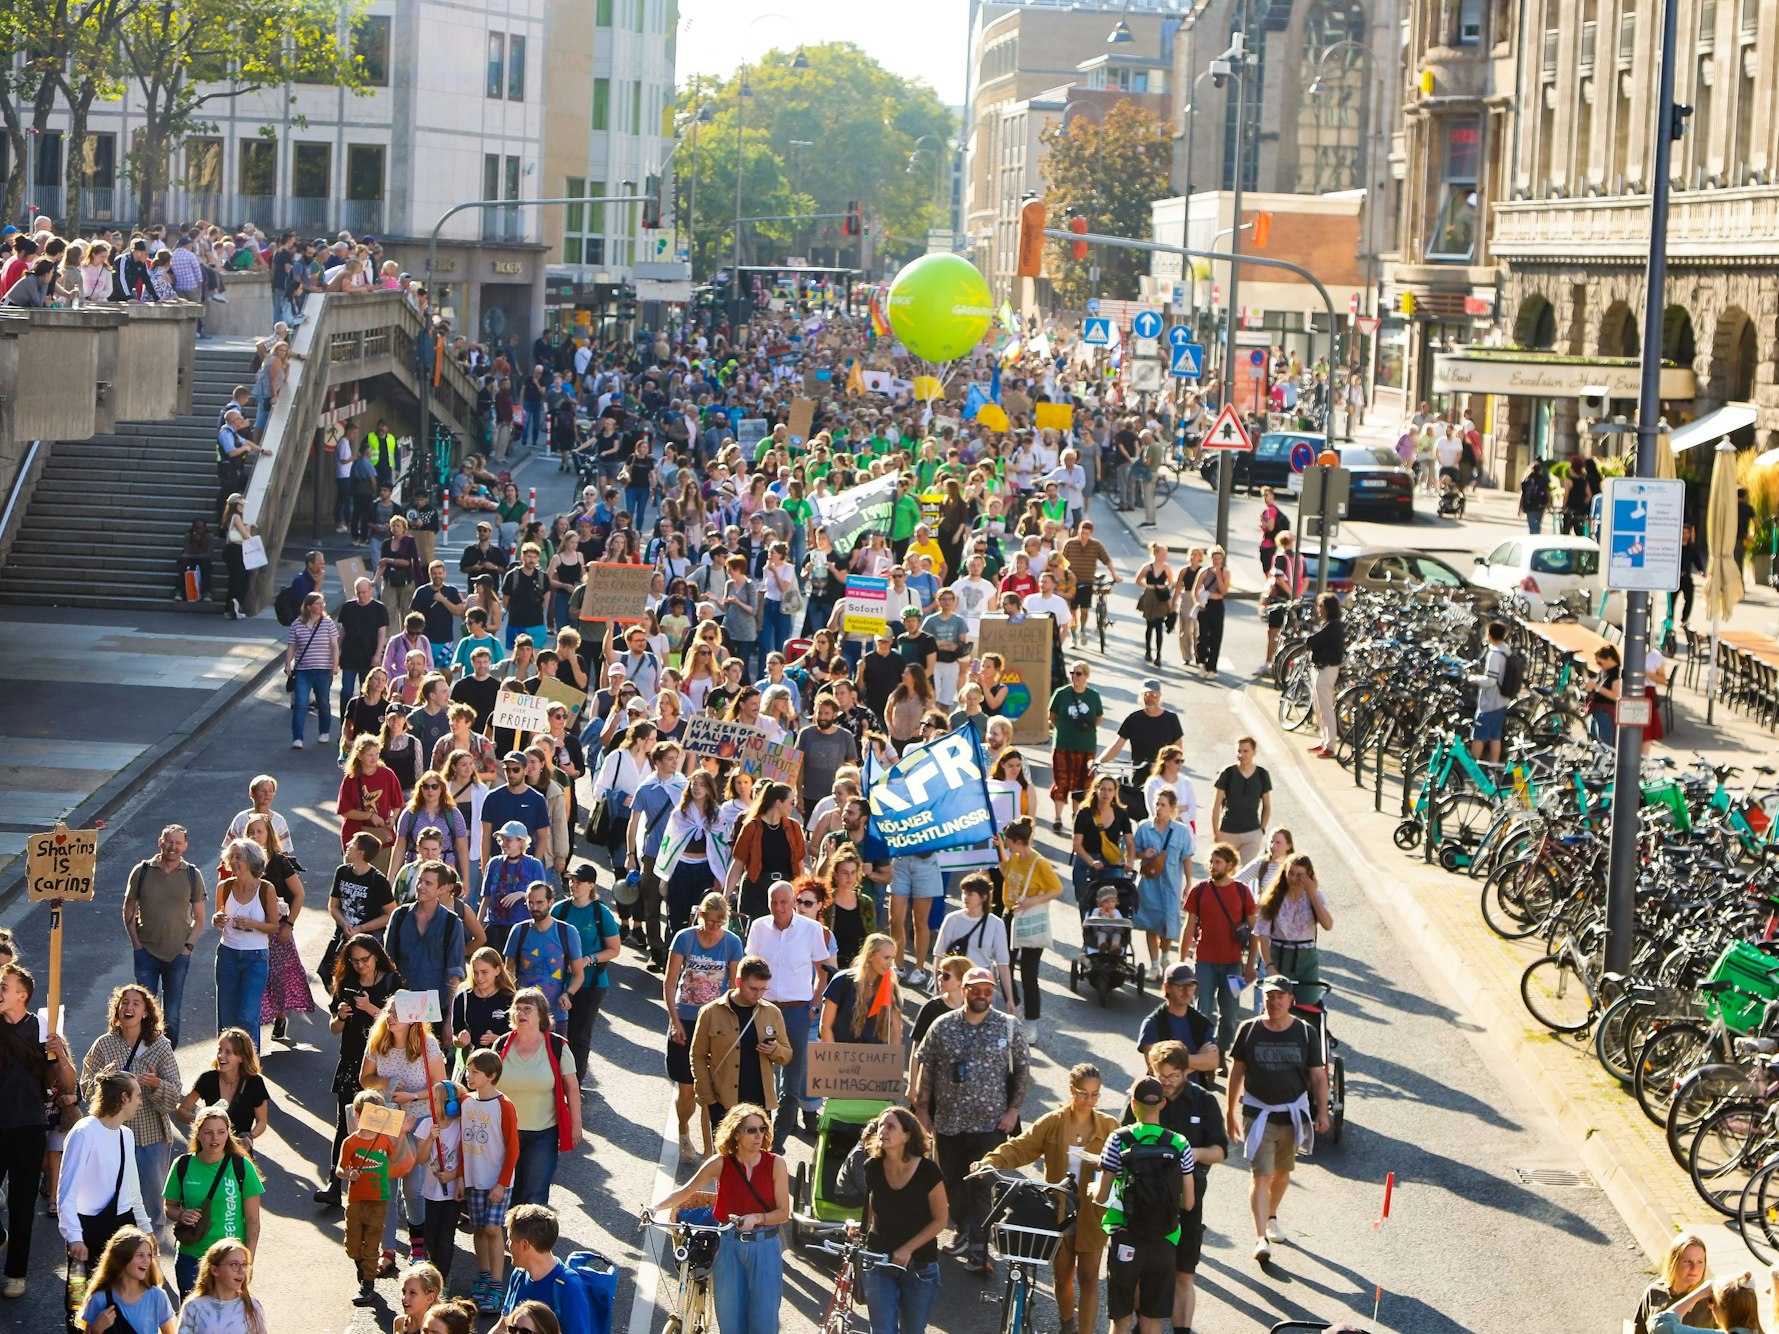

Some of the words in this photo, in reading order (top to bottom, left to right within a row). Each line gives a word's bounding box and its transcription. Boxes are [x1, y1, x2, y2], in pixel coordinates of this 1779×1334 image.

[1509, 371, 1564, 388] Excelsior
[848, 603, 884, 614] Sofort!
[981, 629, 1007, 643] WIR
[1009, 627, 1047, 643] HABEN
[1013, 644, 1045, 660] EINE
[502, 692, 541, 710] PEOPLE
[499, 712, 540, 730] PROFIT
[691, 719, 710, 731] ICH
[746, 736, 764, 751] NO
[756, 752, 795, 773] WITHOUT
[877, 810, 935, 835] KÖLNER
[37, 837, 95, 858] Sharing
[339, 879, 369, 893] BLACKOUT
[814, 1049, 897, 1064] WIRTSCHAFT
[812, 1077, 901, 1093] KLIMASCHUTZ
